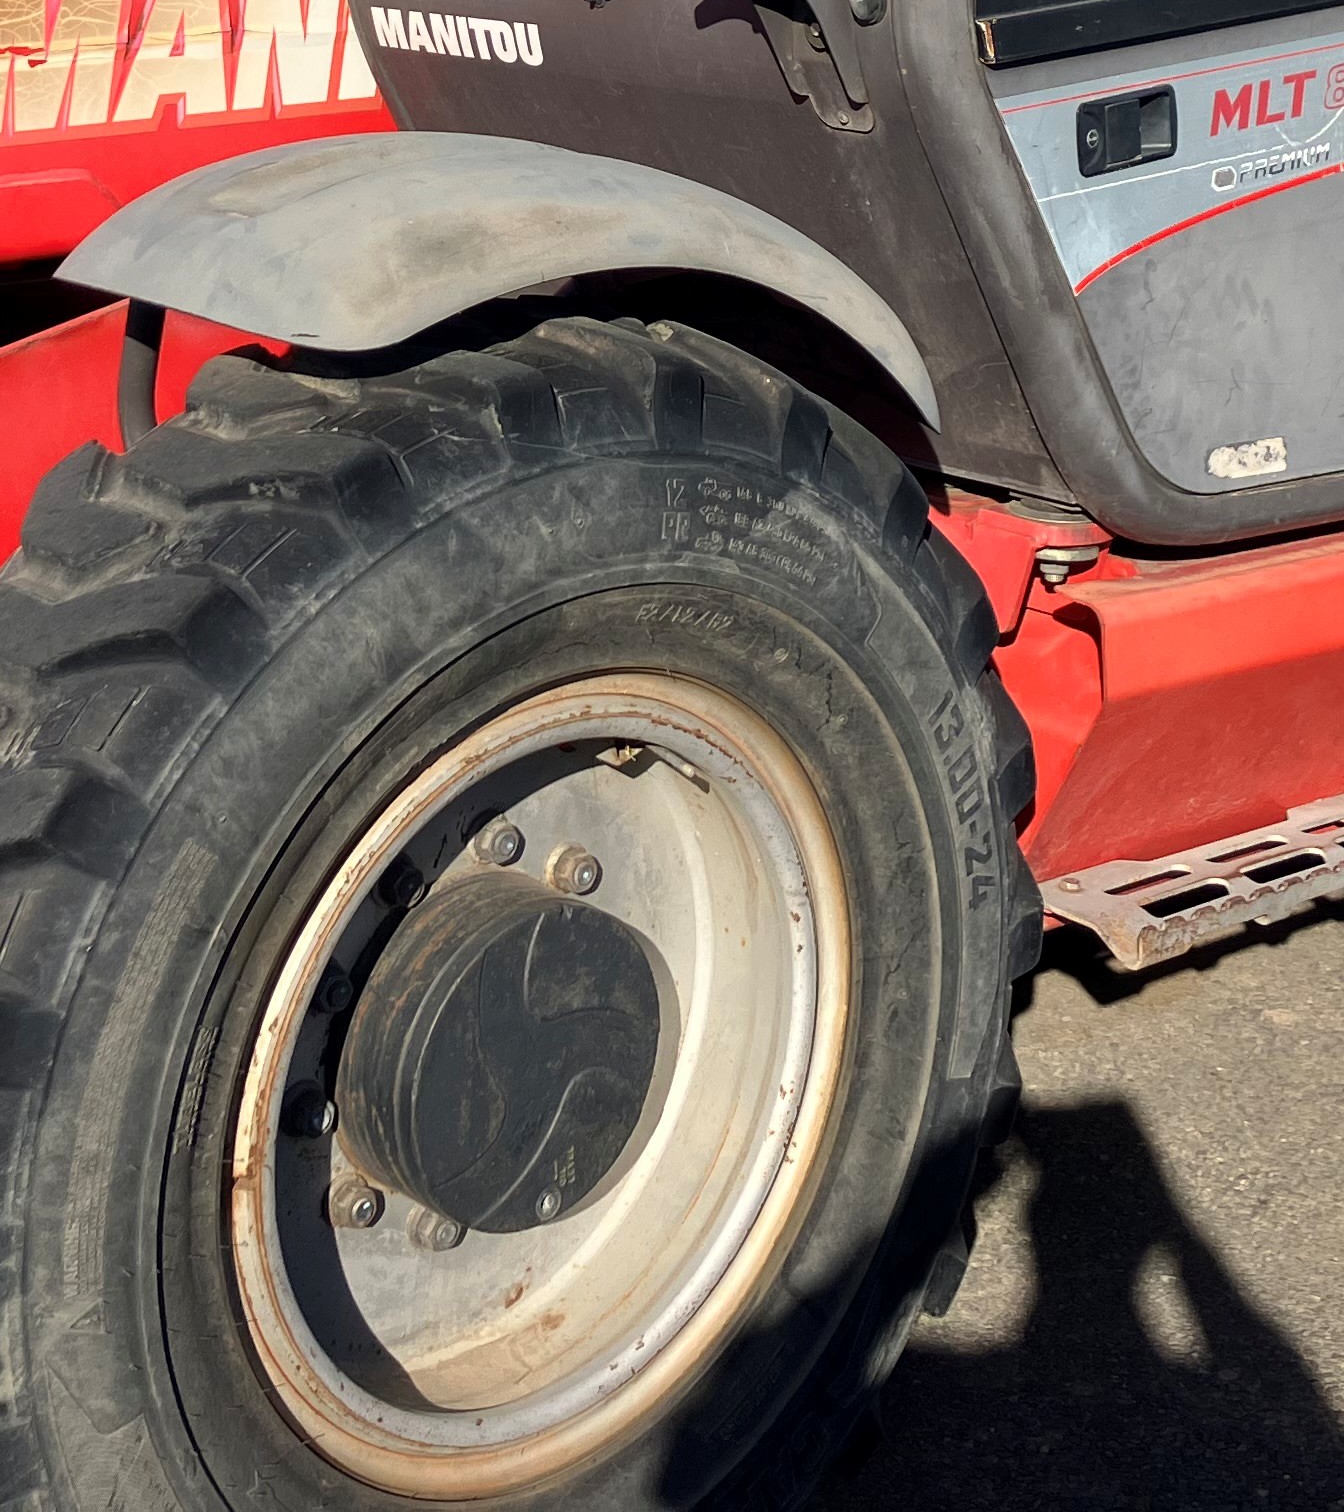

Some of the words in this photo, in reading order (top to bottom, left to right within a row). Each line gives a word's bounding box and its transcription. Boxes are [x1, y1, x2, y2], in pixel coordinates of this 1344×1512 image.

[370, 6, 544, 67] MANITOU
[1210, 70, 1317, 137] MLT
[1239, 142, 1331, 183] PREMIUM
